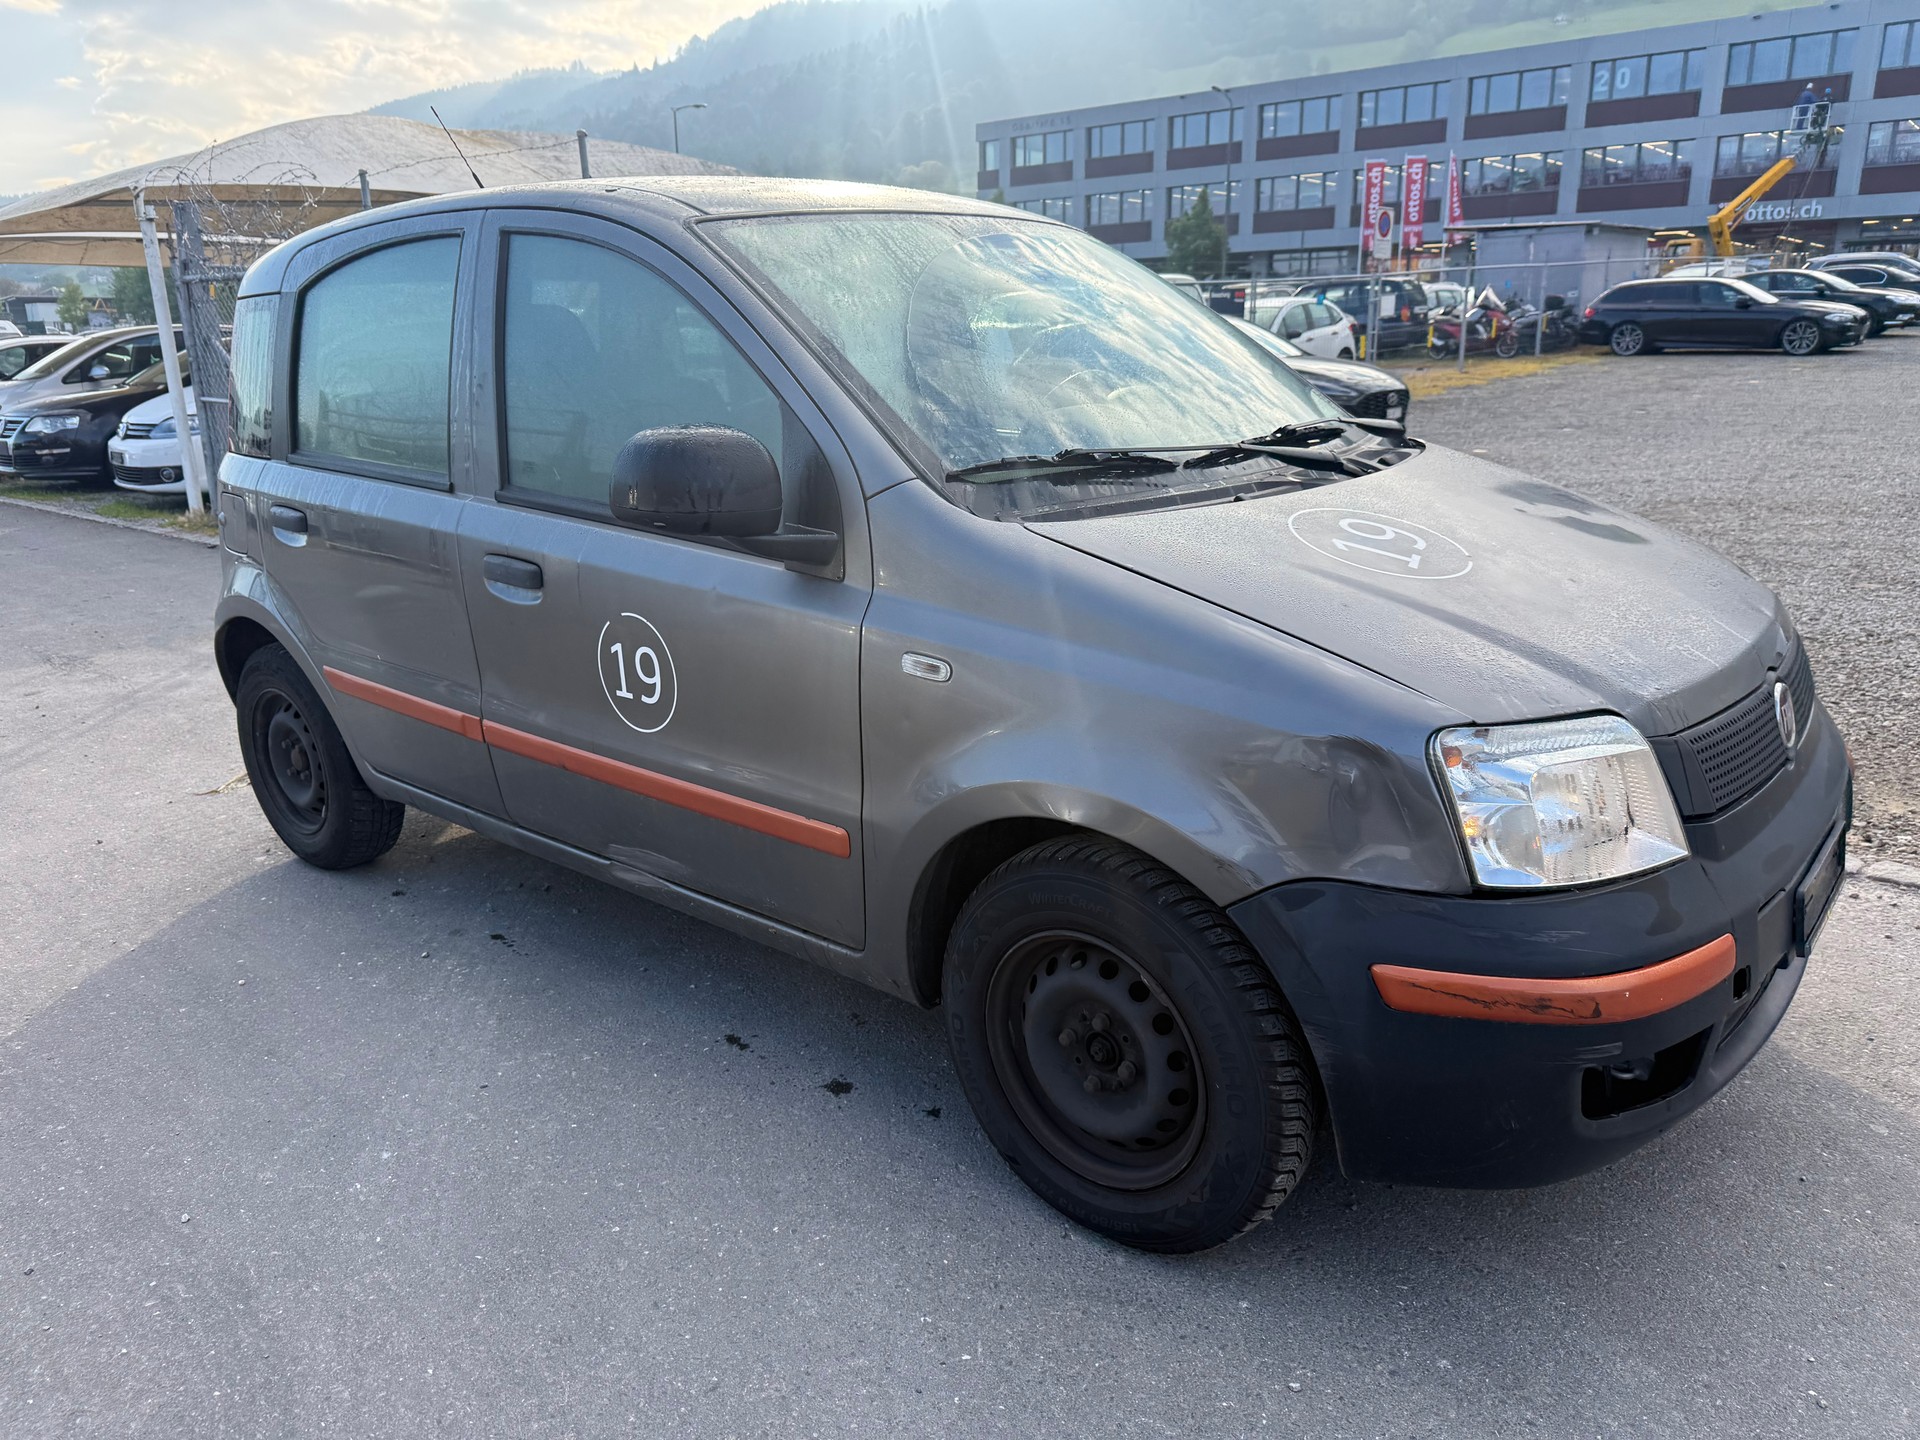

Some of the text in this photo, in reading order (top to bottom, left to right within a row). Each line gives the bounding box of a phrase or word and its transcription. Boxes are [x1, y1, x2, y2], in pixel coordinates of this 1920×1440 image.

[1593, 67, 1630, 91] 20
[1408, 163, 1423, 222] ottos.ch
[1744, 199, 1823, 221] ottos.ch
[1331, 518, 1427, 569] 19
[610, 642, 662, 704] 19
